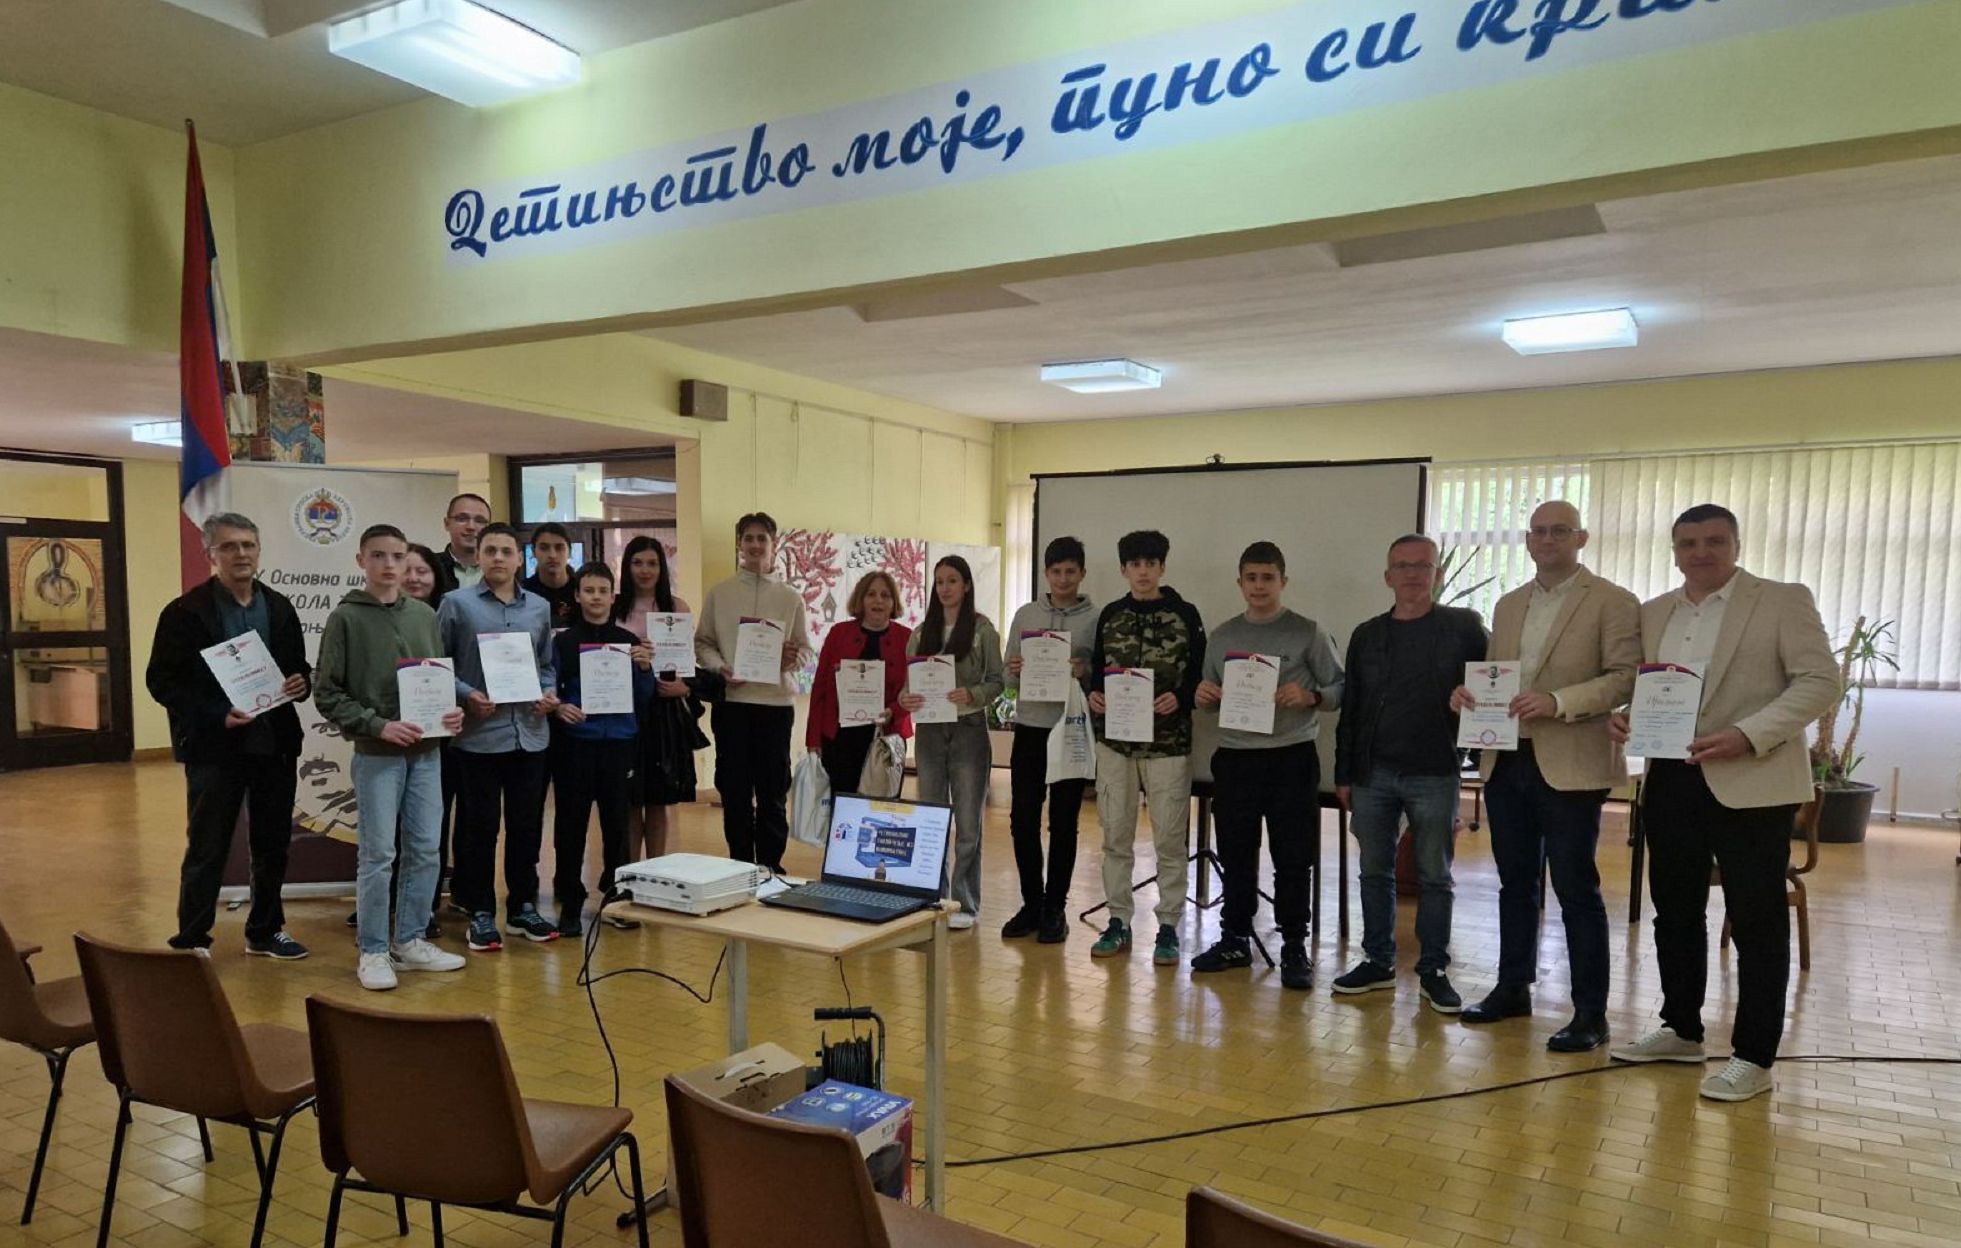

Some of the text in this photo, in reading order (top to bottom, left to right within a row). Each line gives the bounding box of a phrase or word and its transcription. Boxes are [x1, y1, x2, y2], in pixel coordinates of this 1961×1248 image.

[445, 123, 815, 257] Детињство
[832, 90, 1025, 174] моје,
[1050, 42, 1280, 140] пуно
[1304, 12, 1422, 83] си
